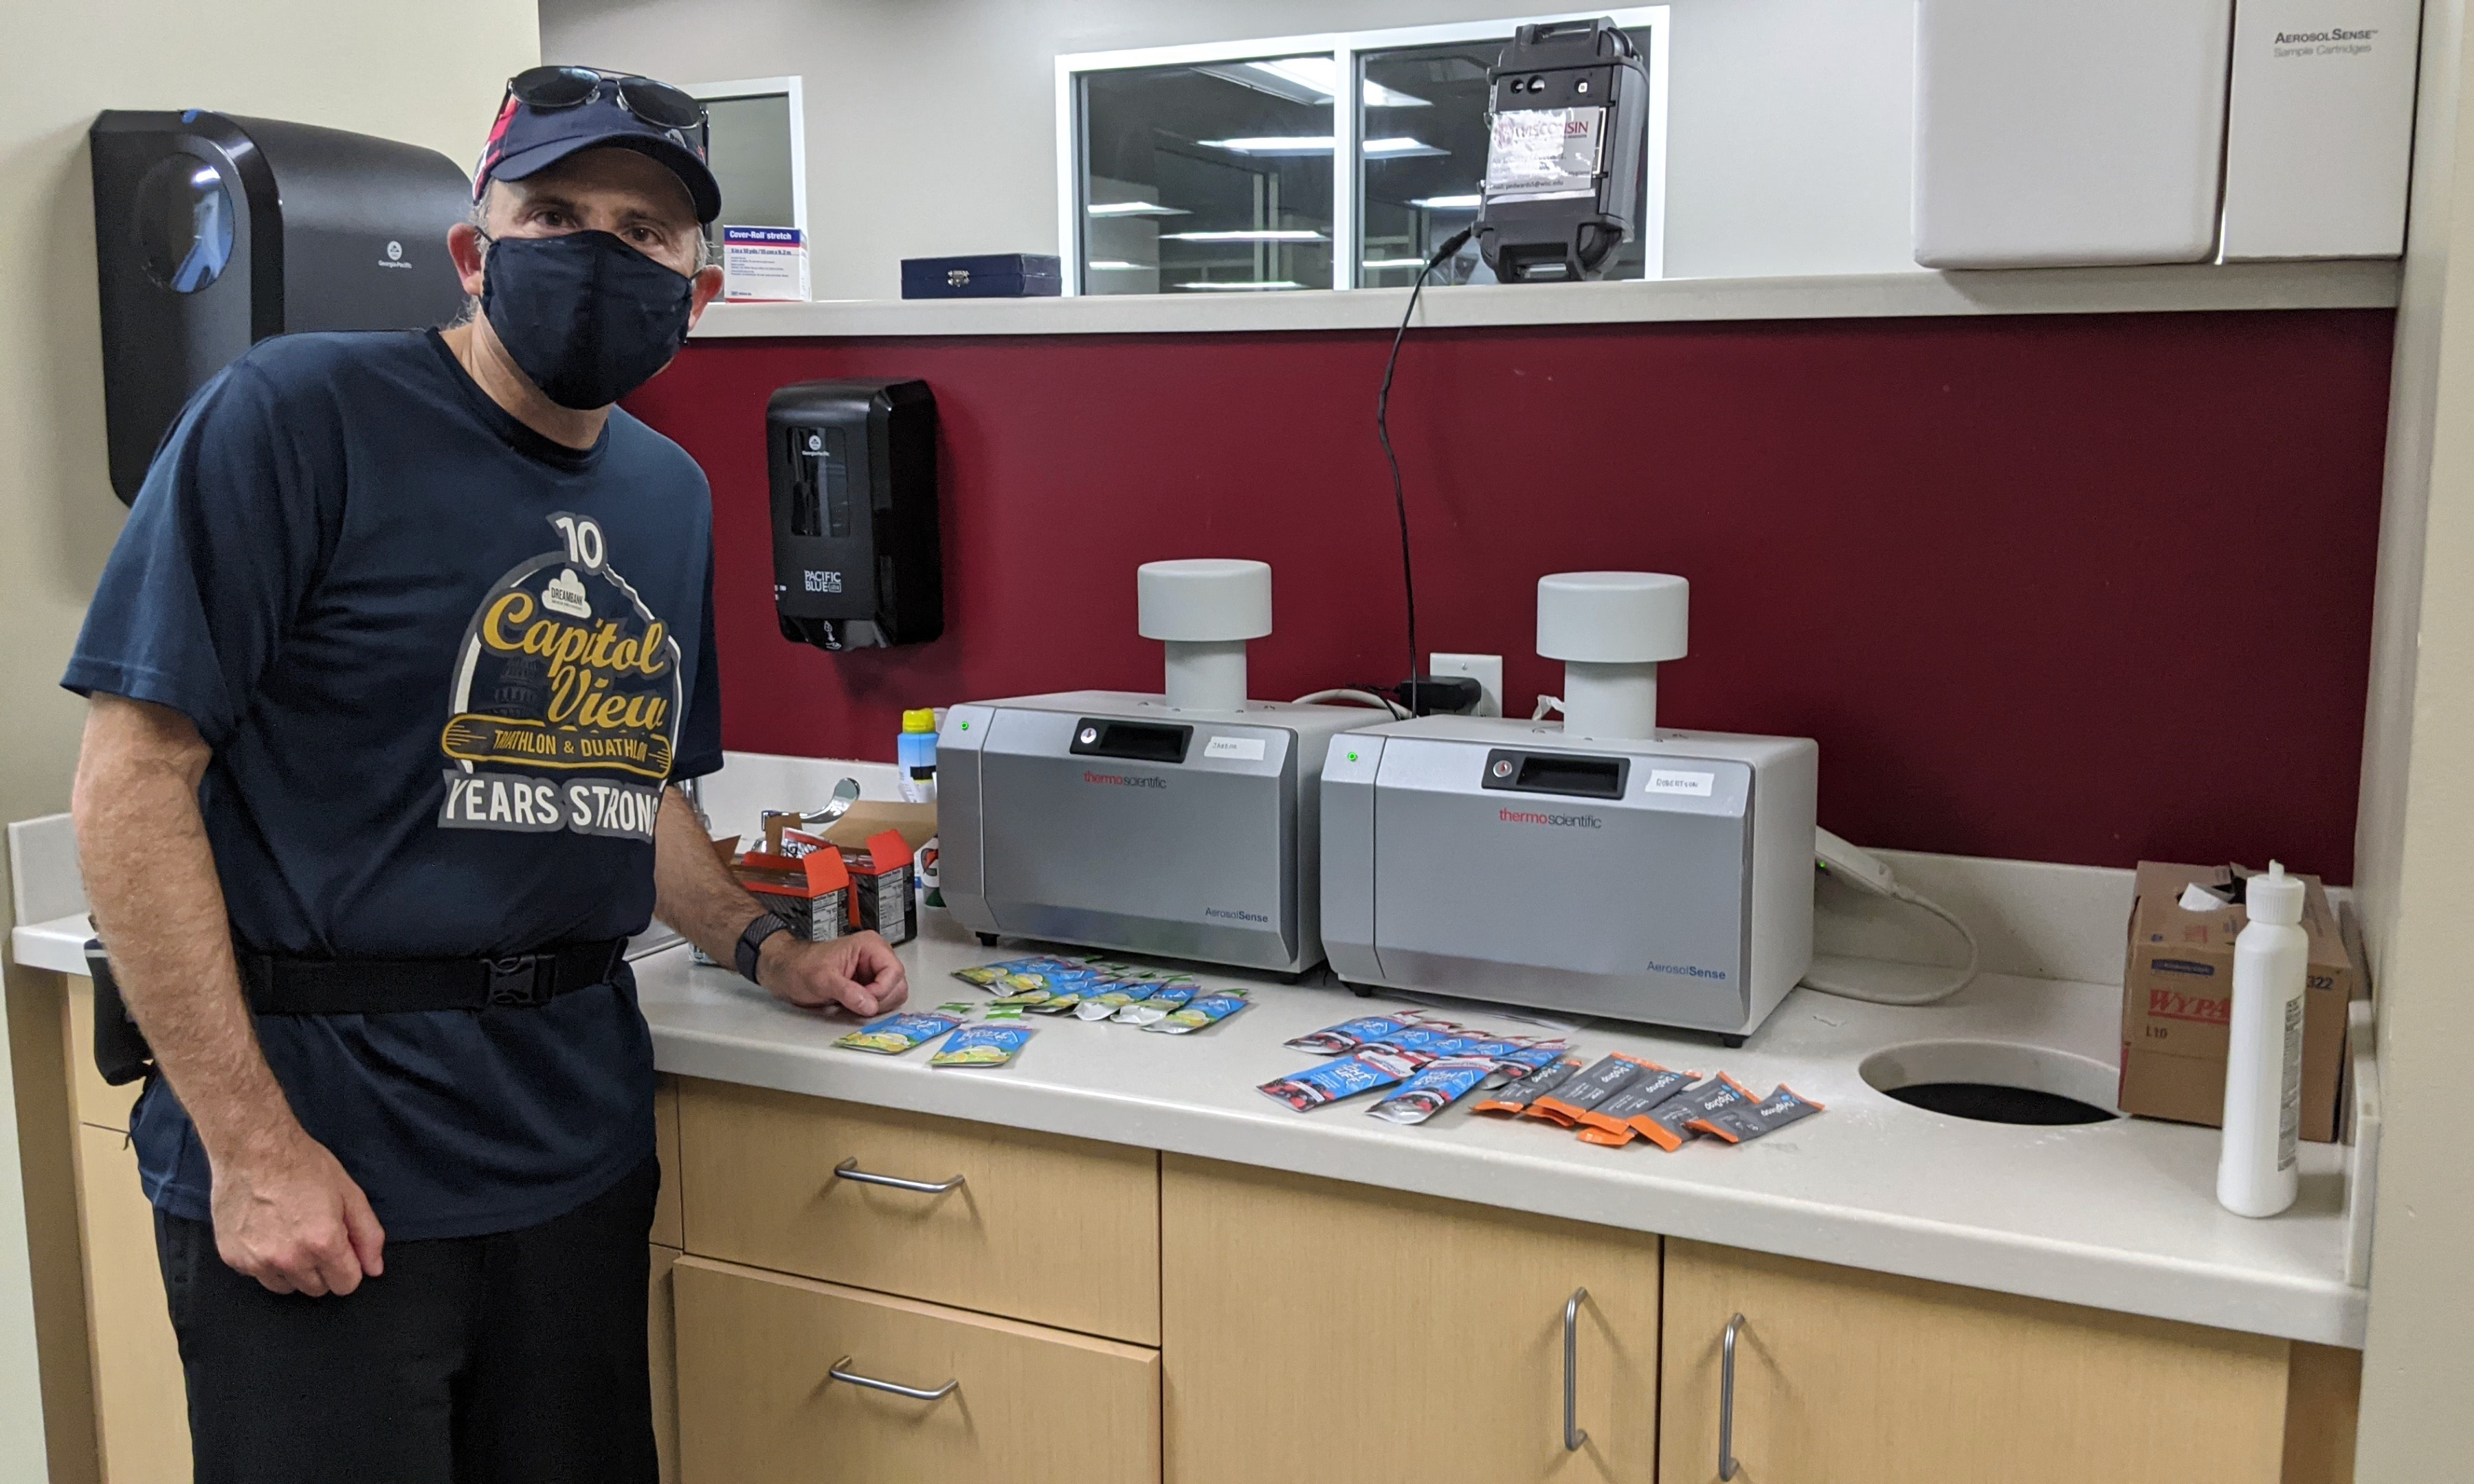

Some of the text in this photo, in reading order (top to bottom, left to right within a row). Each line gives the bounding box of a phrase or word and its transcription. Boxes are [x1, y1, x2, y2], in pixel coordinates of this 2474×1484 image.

[2274, 45, 2372, 57] Sample Cartridges
[766, 232, 792, 240] stretch
[556, 516, 603, 570] 10
[804, 570, 841, 583] PACIFIC
[805, 581, 828, 592] BLUE
[483, 592, 665, 677] Capitol
[548, 664, 667, 730] View
[493, 730, 648, 762] TRIATHLON & DUATHLON
[446, 778, 559, 824] YEARS
[1205, 907, 1268, 922] AerosolSense
[1647, 960, 1726, 979] AerosolSense
